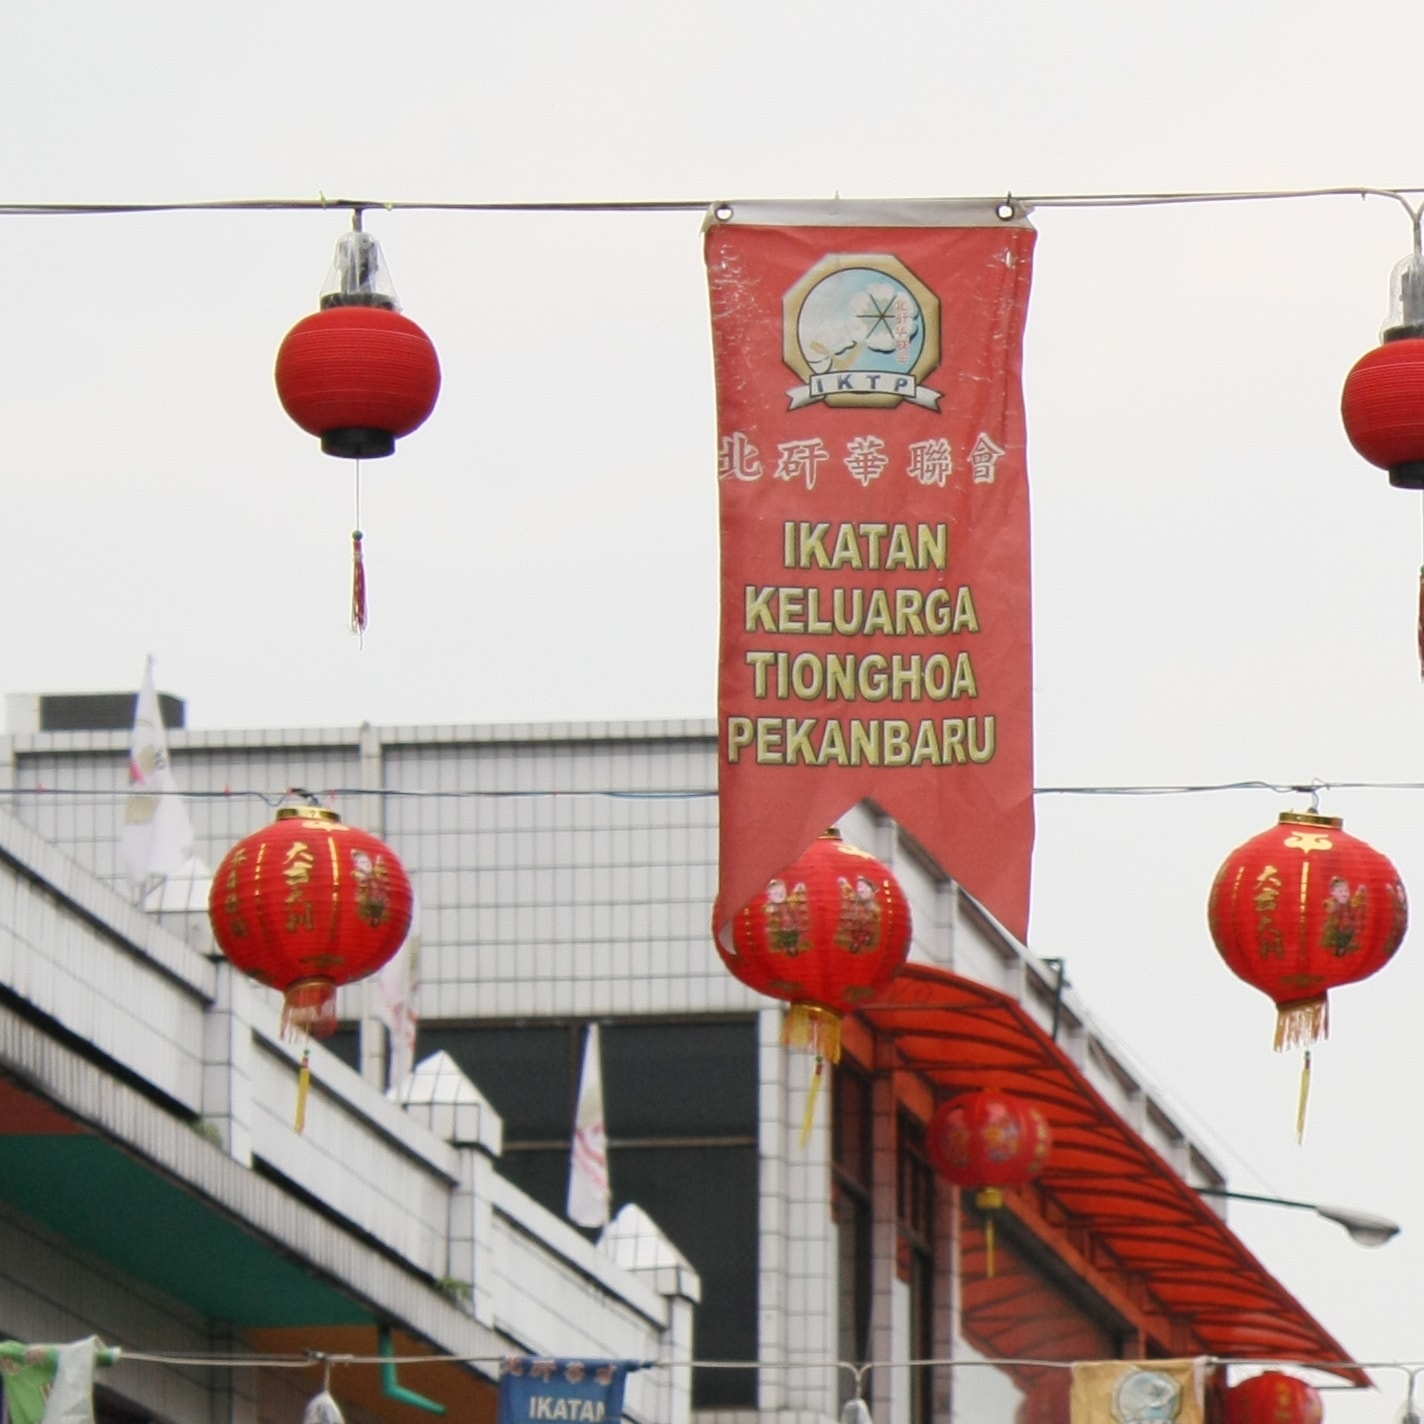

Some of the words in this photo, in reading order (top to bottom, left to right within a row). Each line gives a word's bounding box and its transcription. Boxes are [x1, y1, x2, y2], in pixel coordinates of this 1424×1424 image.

[815, 373, 911, 397] IKTP
[783, 521, 947, 570] IKATAN
[745, 586, 979, 636] KELUARGA
[746, 651, 978, 701] TIONGHOA
[727, 716, 997, 767] PEKANBARU
